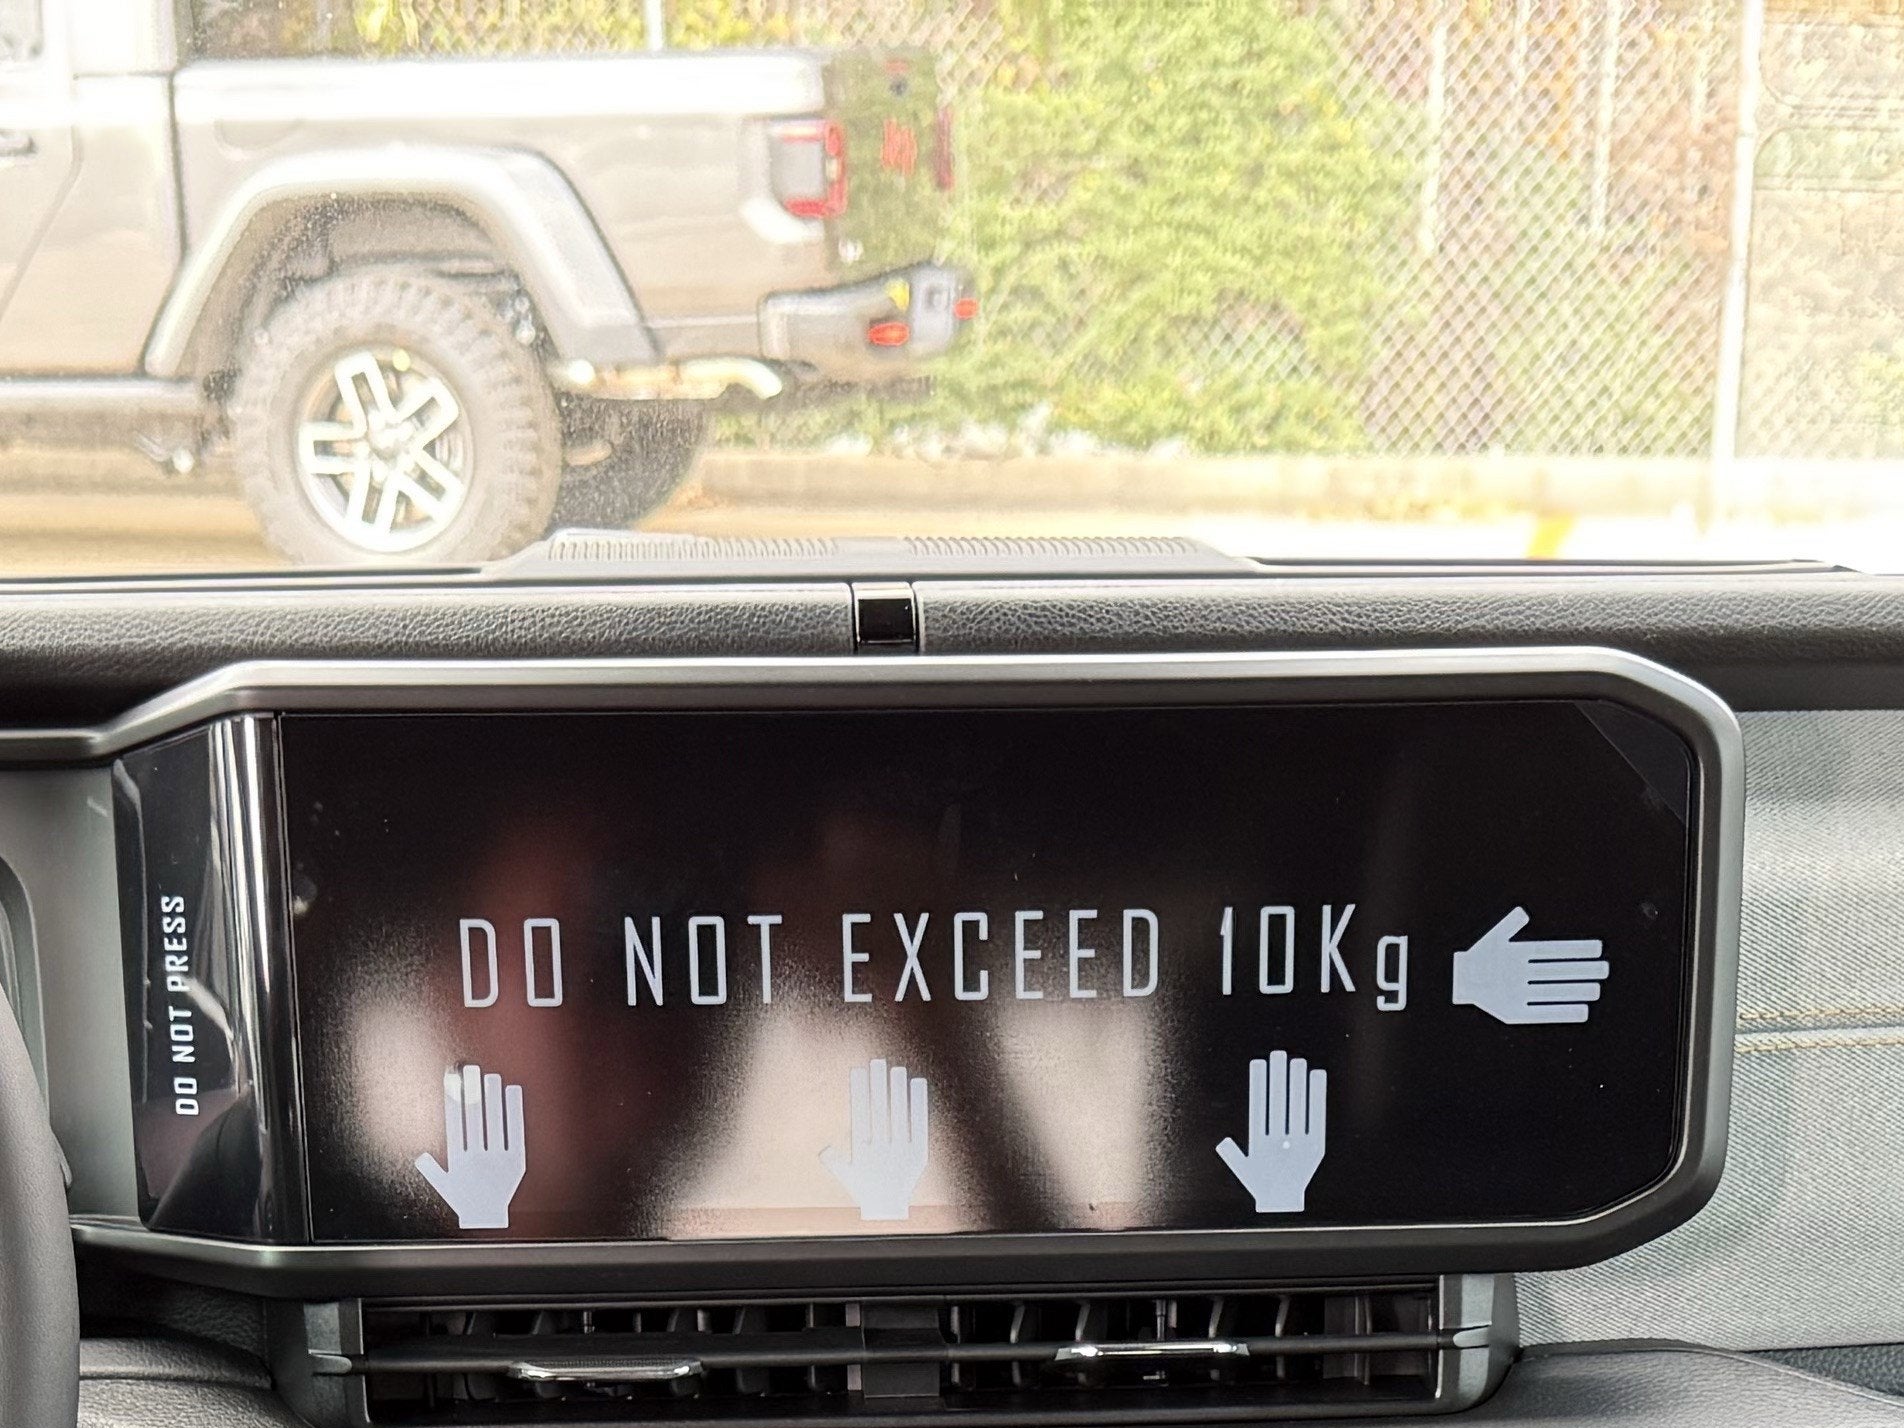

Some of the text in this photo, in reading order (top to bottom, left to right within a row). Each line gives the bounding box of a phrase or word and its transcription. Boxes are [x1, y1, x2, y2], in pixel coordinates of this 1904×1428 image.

[160, 895, 200, 1117] DO NOT PRESS
[459, 902, 1410, 1013] DO NOT EXCEED 10Kg
